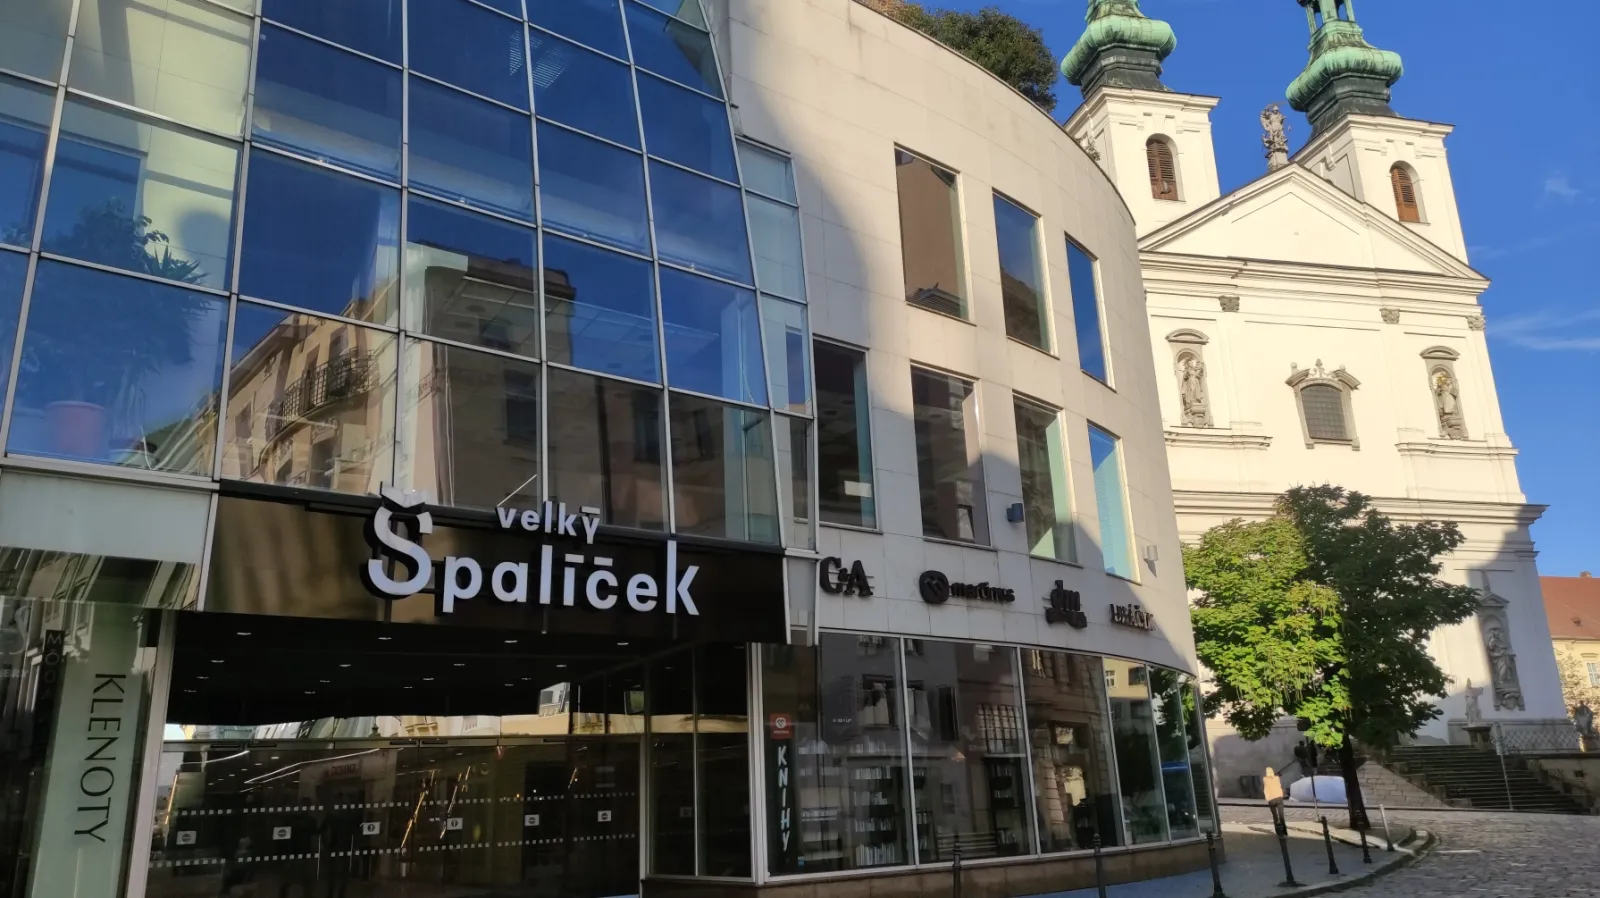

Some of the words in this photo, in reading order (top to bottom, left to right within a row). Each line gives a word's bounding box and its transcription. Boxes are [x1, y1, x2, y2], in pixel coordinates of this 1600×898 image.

[820, 556, 873, 596] C&A
[1050, 580, 1080, 611] dm
[74, 673, 127, 843] KLENOTY
[777, 745, 791, 852] KNIHY
